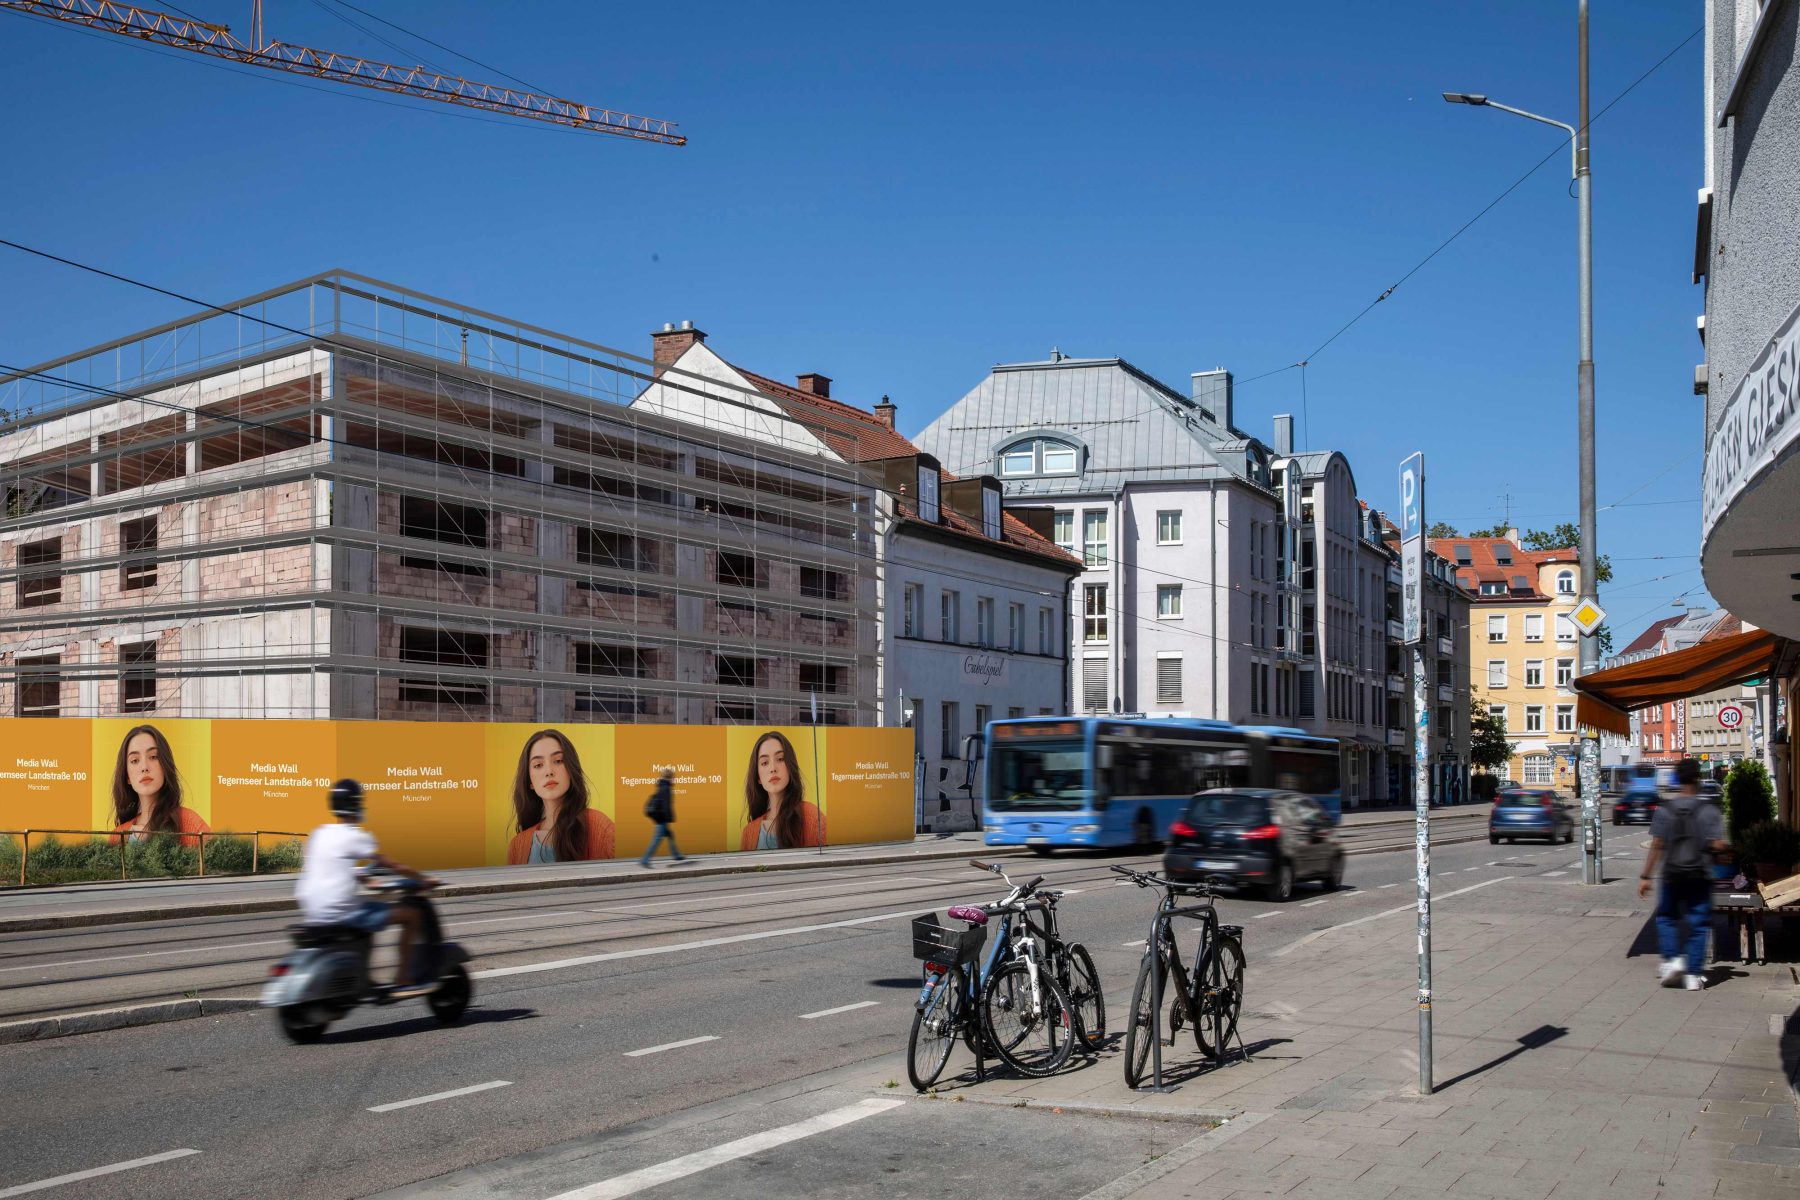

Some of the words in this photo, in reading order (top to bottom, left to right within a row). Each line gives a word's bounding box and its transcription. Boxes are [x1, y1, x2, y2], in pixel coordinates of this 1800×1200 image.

[1747, 340, 1800, 457] GIESI
[1402, 468, 1415, 531] P
[1723, 712, 1738, 723] 30
[16, 758, 39, 768] Media
[40, 758, 59, 768] Wall
[250, 763, 277, 773] Media
[278, 763, 299, 773] Wall
[855, 762, 875, 770] Media
[875, 761, 889, 770] Wall
[387, 767, 418, 776] Media
[419, 766, 443, 776] Wall
[677, 764, 695, 773] Wall
[0, 771, 27, 780] ernseer
[28, 770, 71, 781] Landstraße
[72, 772, 87, 781] 100
[671, 775, 707, 784] ndstraße
[708, 775, 722, 783] 100
[831, 772, 864, 782] Tegernseer
[865, 772, 899, 780] Landstraße
[899, 771, 911, 779] 100
[217, 775, 263, 787] Tegernseer
[264, 776, 312, 787] Landstraße
[315, 778, 331, 787] 100
[403, 779, 459, 790] Landstraße
[461, 779, 479, 789] 100
[263, 790, 289, 798] München
[402, 794, 432, 802] München
